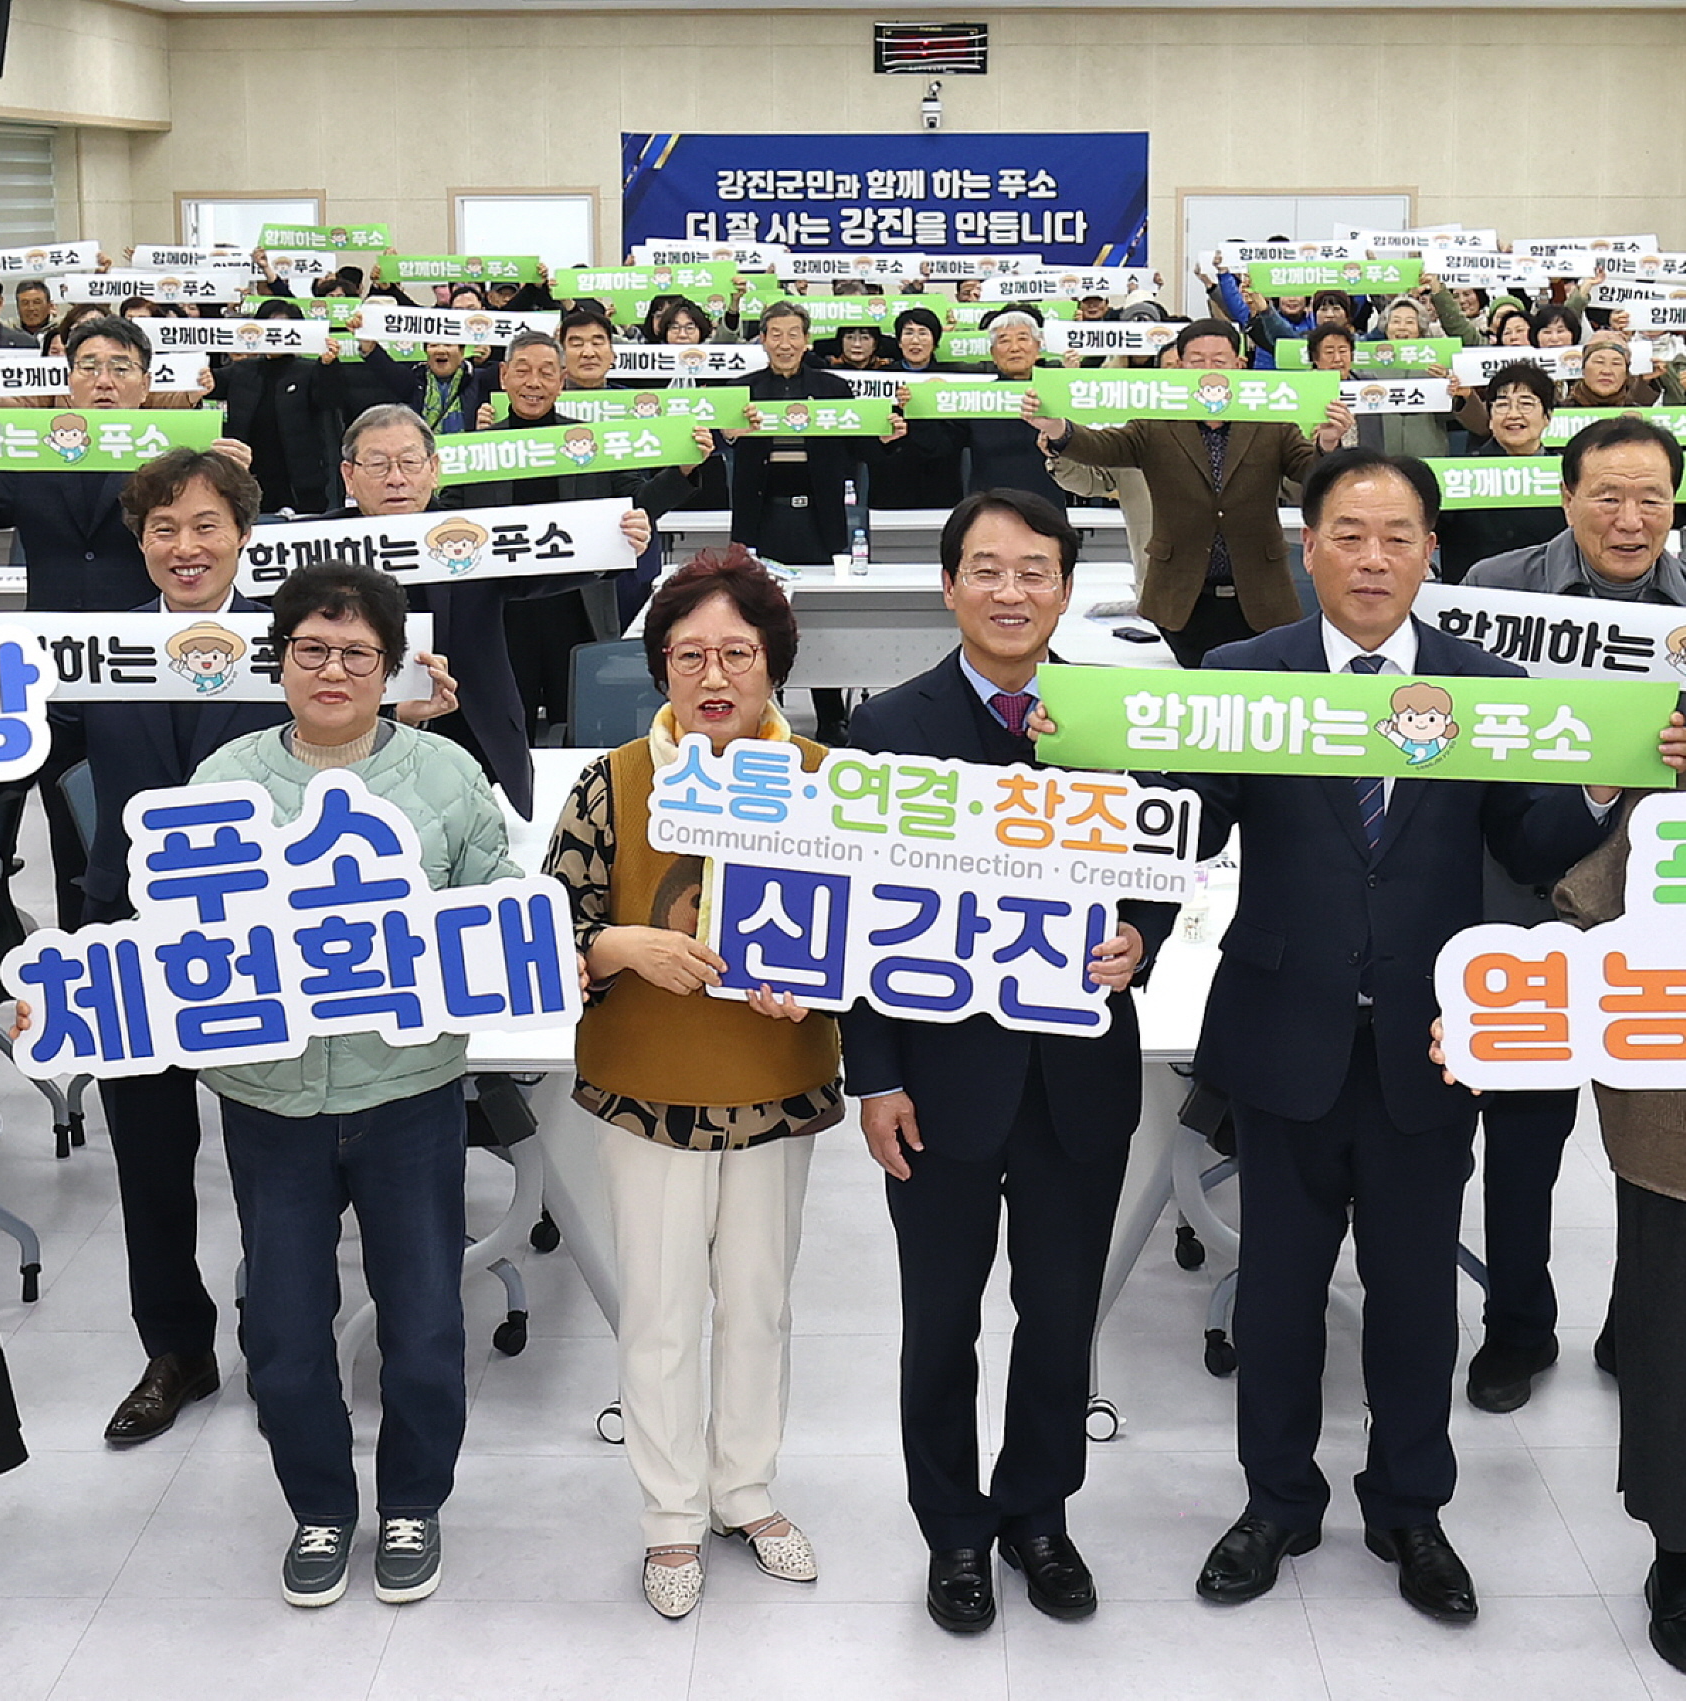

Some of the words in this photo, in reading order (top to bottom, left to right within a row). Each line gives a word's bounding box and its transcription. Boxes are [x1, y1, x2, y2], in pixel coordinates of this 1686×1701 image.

[716, 169, 861, 200] 강진군민과
[867, 169, 926, 200] 함께
[932, 169, 992, 200] 하는
[997, 169, 1058, 200] 푸소
[685, 211, 716, 243] 더
[725, 211, 760, 244] 잘
[765, 210, 832, 245] 사는
[839, 207, 947, 246] 강진을
[954, 210, 1087, 246] 만듭니다
[264, 229, 327, 247] 함께하는
[352, 230, 384, 246] 푸소
[50, 249, 81, 267] 푸소
[734, 250, 762, 264] 푸소
[1239, 248, 1296, 260] 함께하는
[1320, 246, 1348, 258] 푸소
[1446, 255, 1512, 270] 함께하는
[295, 258, 323, 273] 푸소
[398, 260, 462, 278] 함께하는
[487, 261, 520, 277] 푸소
[793, 259, 851, 274] 함께하는
[875, 259, 903, 274] 푸소
[1270, 267, 1340, 285] 함께하는
[1367, 266, 1400, 283] 푸소
[88, 280, 155, 296] 함께하는
[183, 280, 216, 296] 푸소
[577, 271, 649, 291] 함께하는
[677, 269, 713, 288] 푸소
[1000, 280, 1057, 295] 함께하는
[1082, 276, 1110, 291] 푸소
[801, 301, 863, 320] 께하는
[384, 313, 461, 336] 함께하는
[159, 327, 234, 346] 함께하는
[265, 327, 302, 346] 푸소
[1067, 330, 1143, 349] 함께하는
[709, 352, 747, 371] 푸소
[1400, 345, 1437, 365] 푸소
[0, 367, 69, 388] 함께하
[846, 380, 905, 398] 함께하
[1069, 379, 1189, 410] 함께하는
[1238, 380, 1299, 411] 푸소
[1388, 388, 1425, 406] 푸소
[555, 400, 627, 423] 께하는
[666, 397, 715, 422] 푸소
[935, 389, 1025, 414] 함께하는
[815, 408, 862, 430] 푸소
[98, 422, 171, 458] 푸소
[438, 438, 557, 475] 함께하는
[602, 429, 662, 461] 푸소
[1443, 467, 1561, 498] 함께하는
[246, 532, 419, 583] 함께하는
[491, 521, 575, 563] 푸소
[1437, 607, 1655, 673] 함께하는
[38, 635, 158, 684] 하는
[1123, 690, 1369, 757] 함께하는
[1471, 700, 1593, 763] 푸소
[141, 787, 412, 924] 푸소
[657, 818, 863, 864] Communication
[889, 842, 1044, 882] Connection
[1069, 861, 1187, 895] Creation
[19, 894, 566, 1064] 체험확대
[1463, 950, 1574, 1062] 열
